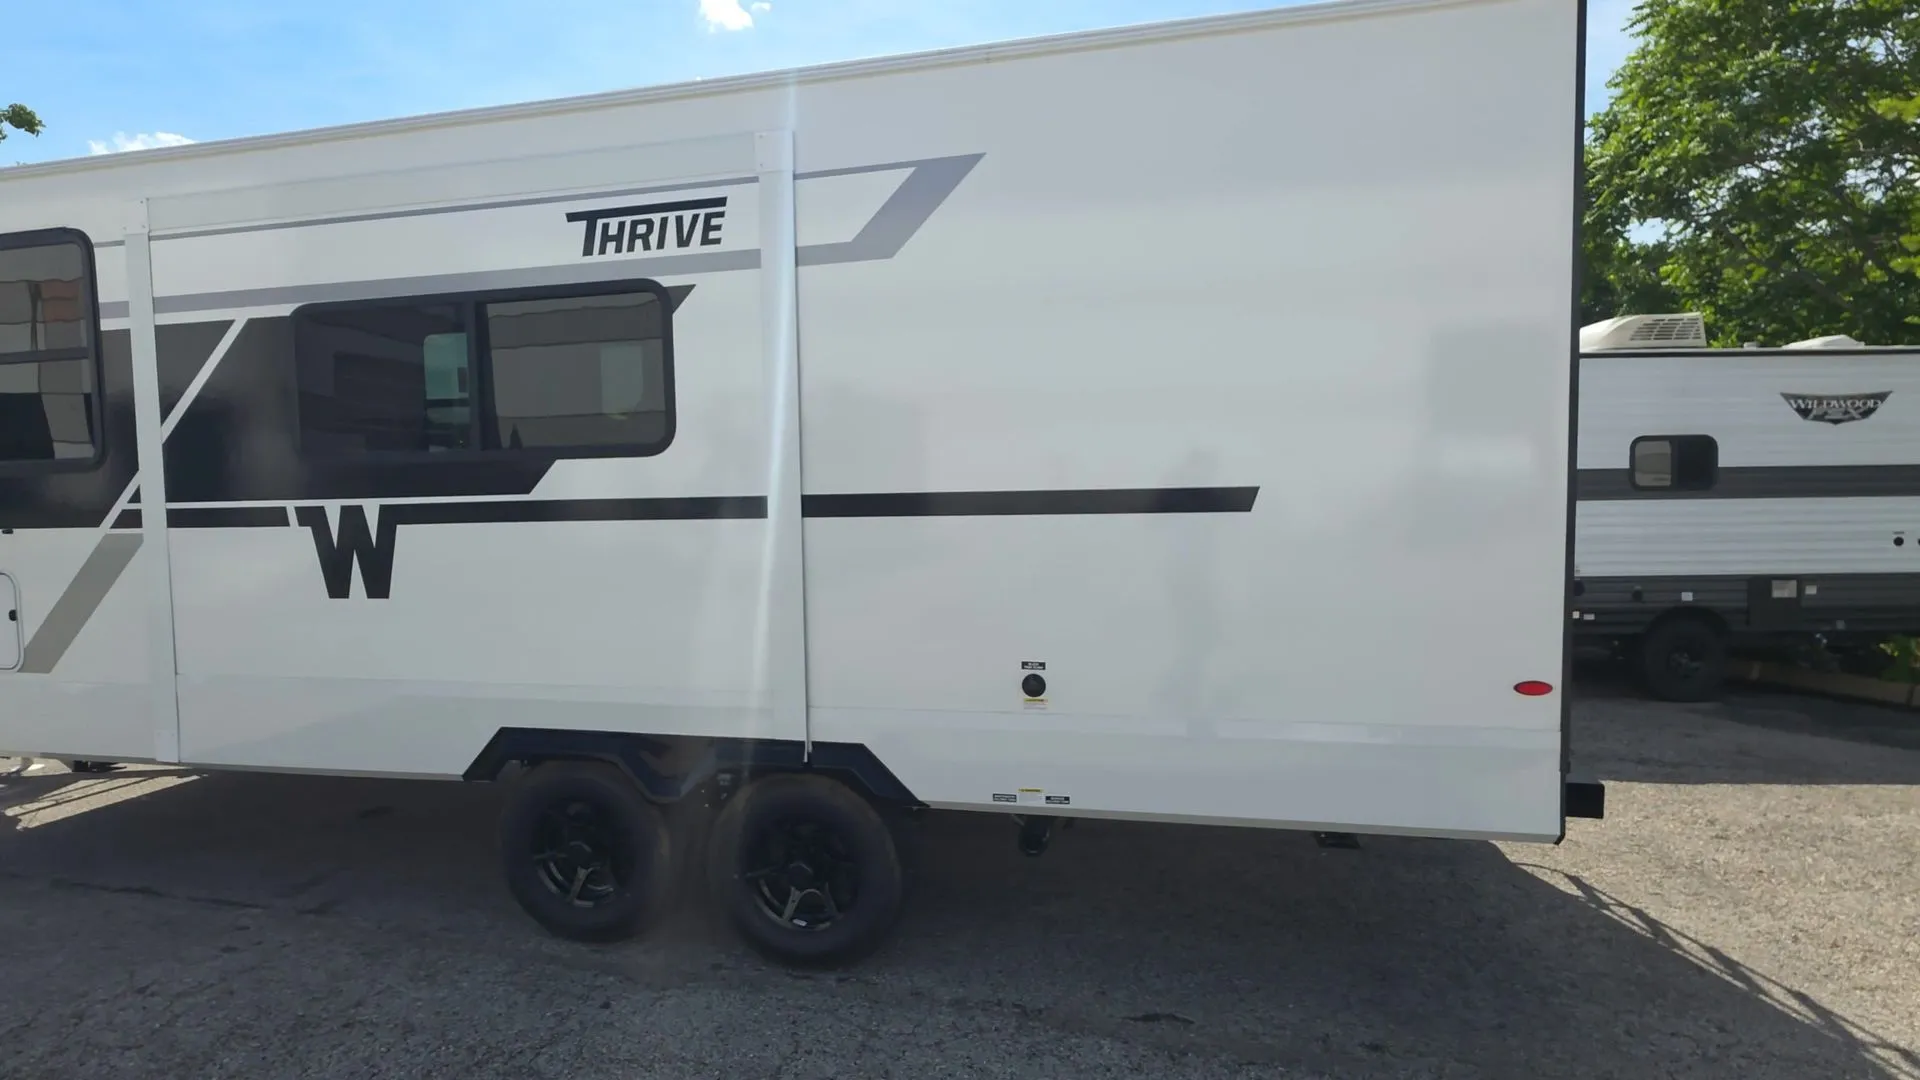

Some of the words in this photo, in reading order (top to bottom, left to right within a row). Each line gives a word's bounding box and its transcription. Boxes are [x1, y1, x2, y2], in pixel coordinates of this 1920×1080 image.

[565, 196, 728, 257] THRIVE
[1788, 398, 1882, 410] WILDWOOD
[295, 503, 398, 599] W
